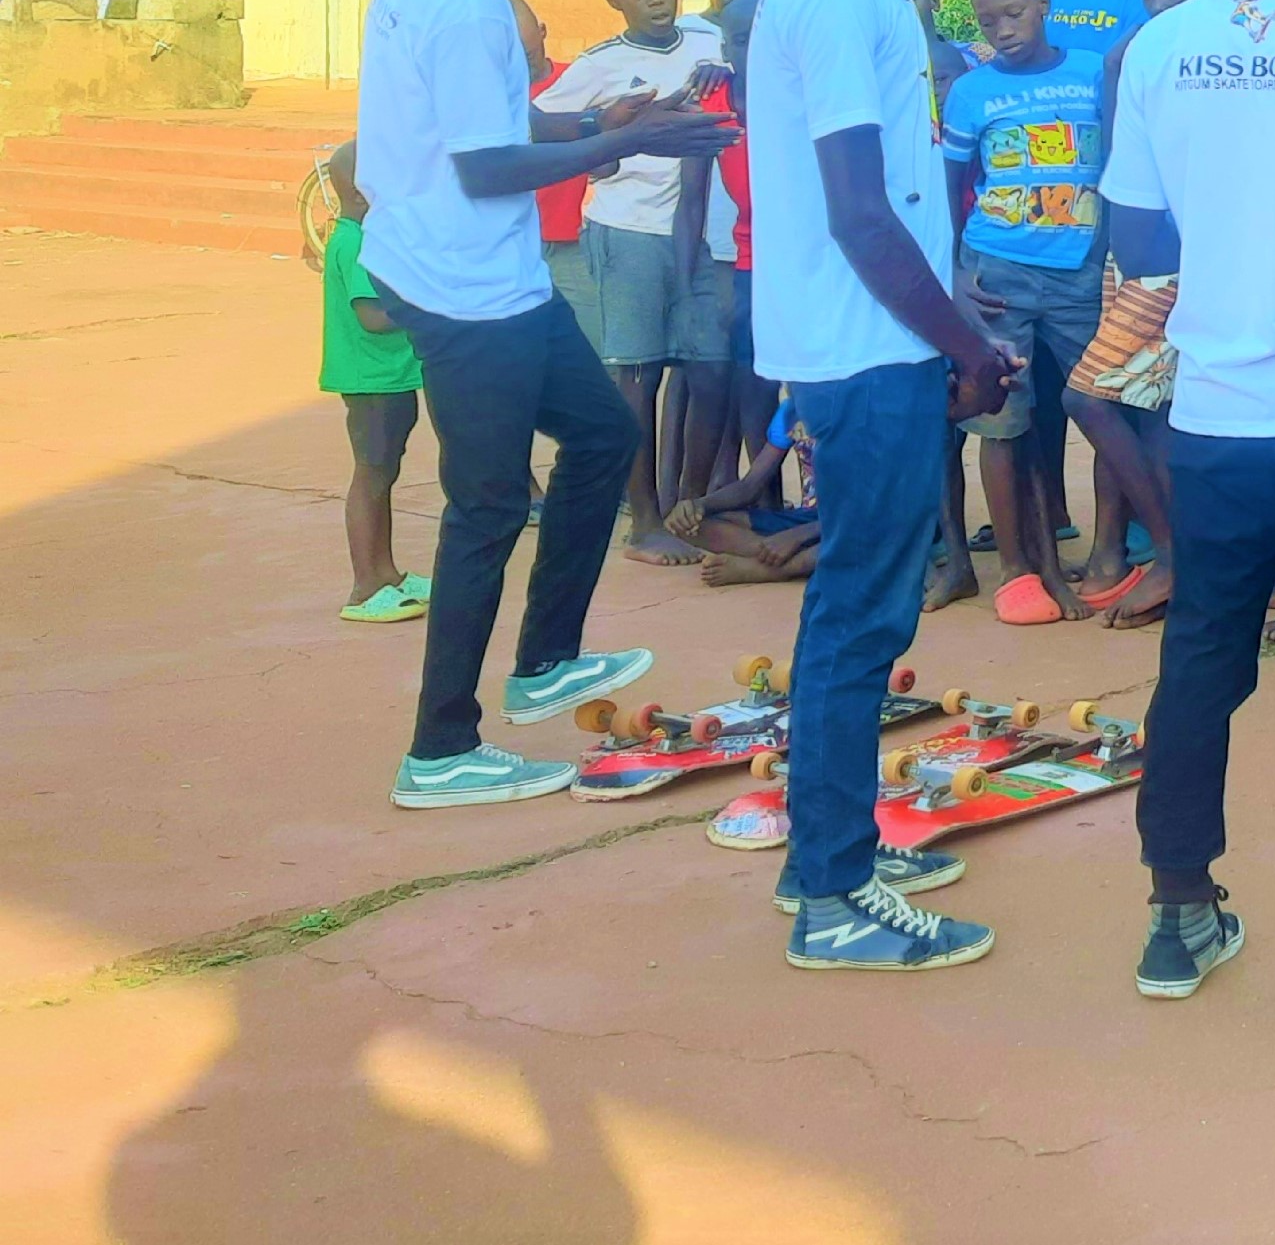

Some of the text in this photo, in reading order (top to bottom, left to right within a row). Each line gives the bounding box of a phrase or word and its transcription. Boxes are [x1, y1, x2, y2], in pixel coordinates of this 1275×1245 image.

[1178, 54, 1245, 78] KISS
[983, 84, 1095, 117] ALL I KNOW
